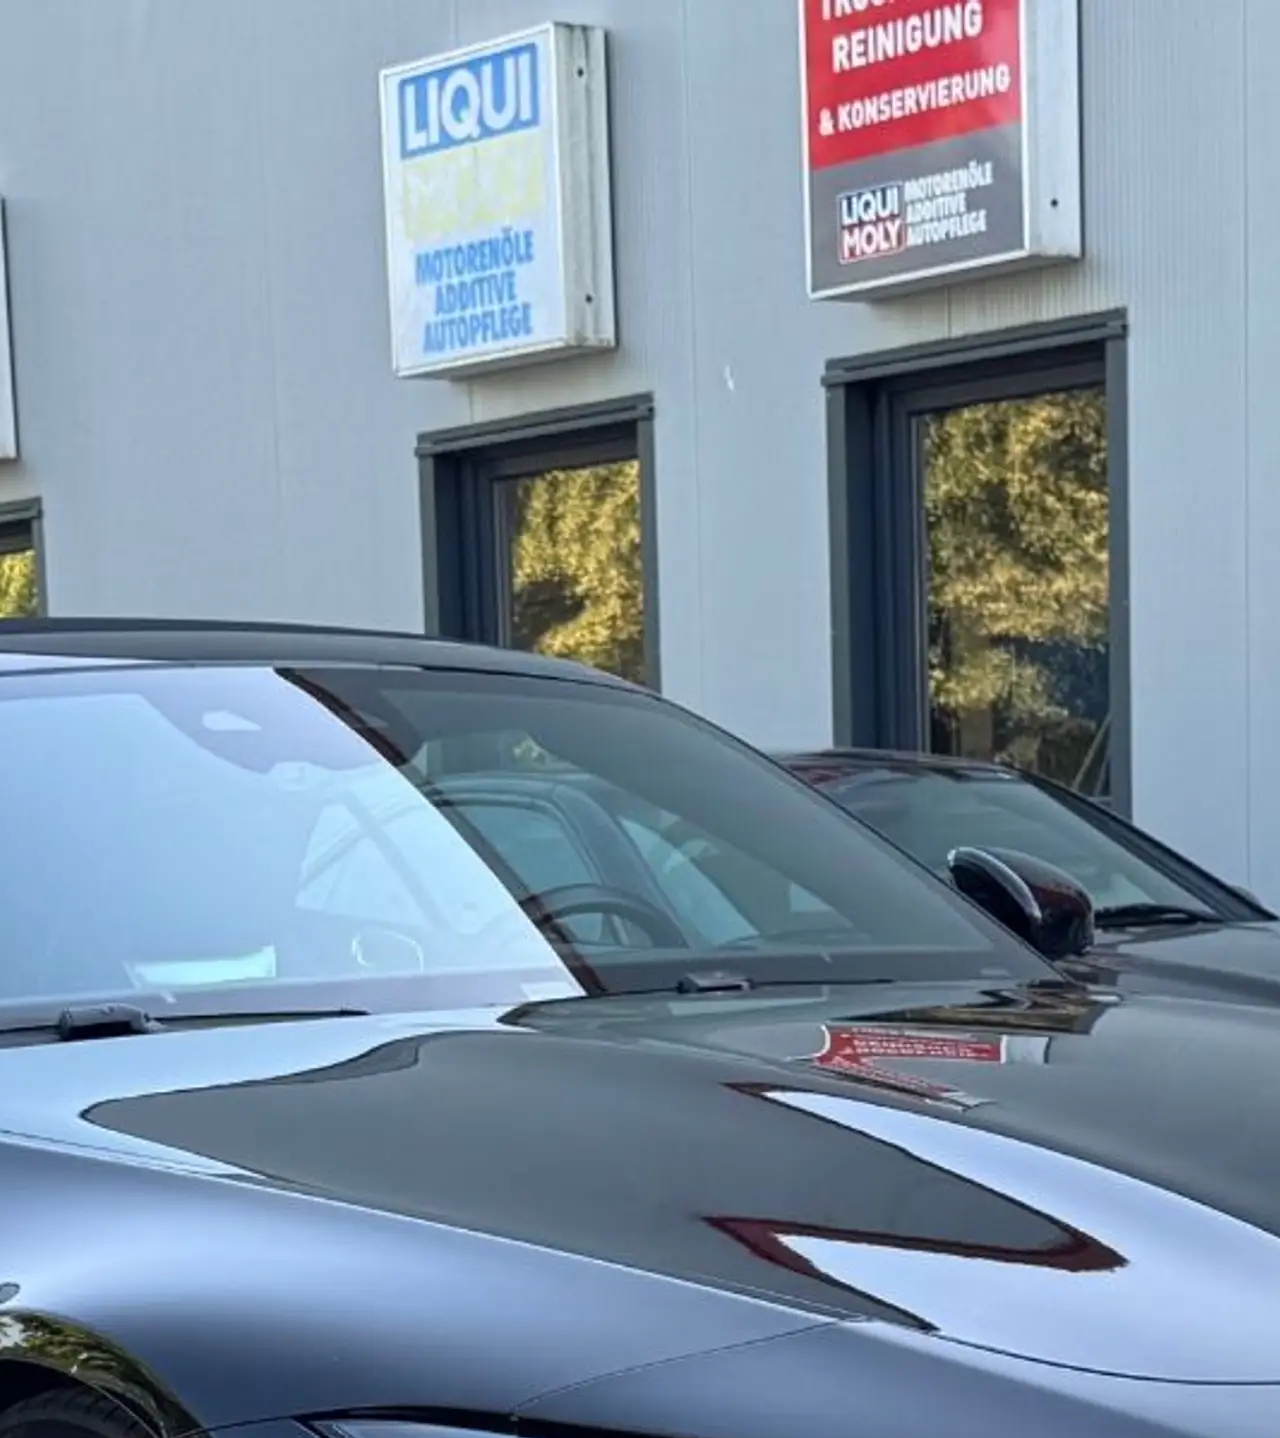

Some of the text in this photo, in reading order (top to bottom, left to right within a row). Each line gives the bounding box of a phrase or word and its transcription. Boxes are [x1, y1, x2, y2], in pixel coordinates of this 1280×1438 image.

[832, 2, 984, 73] REINIGUNG
[404, 52, 535, 152] LIQUI
[818, 63, 1011, 136] & KONSERVIERUNG
[841, 187, 899, 225] LIQUI
[906, 192, 966, 224] ADDITIVE
[415, 226, 534, 286] MOTORENÖLE
[842, 220, 902, 258] MOLY
[435, 271, 517, 315] ADDITIVE
[423, 303, 533, 352] AUTOPFLEGE
